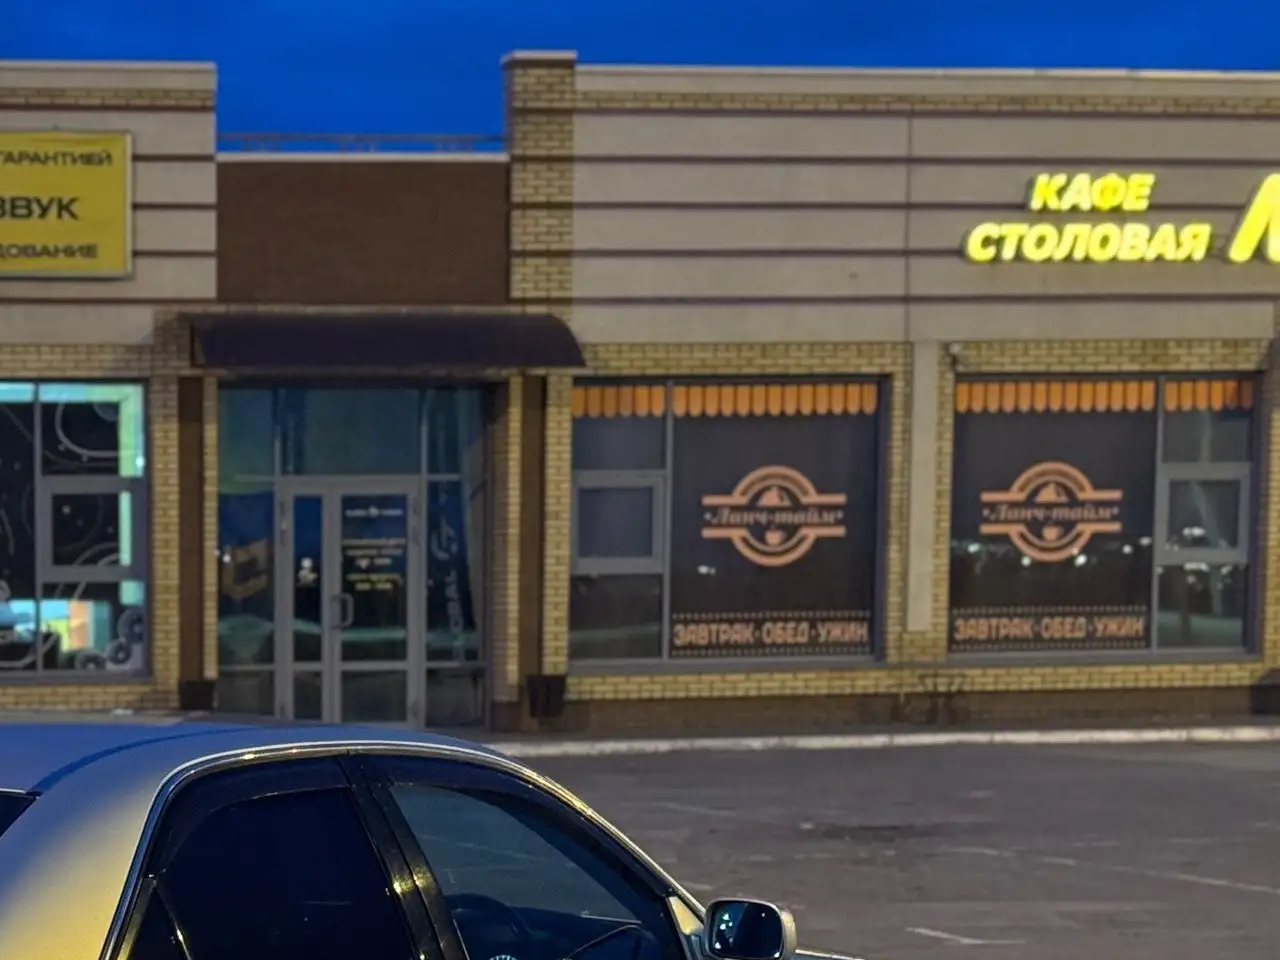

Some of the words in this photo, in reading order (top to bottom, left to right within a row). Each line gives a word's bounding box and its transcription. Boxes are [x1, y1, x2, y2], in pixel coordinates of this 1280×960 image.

[1030, 172, 1156, 212] КАФЕ
[966, 221, 1212, 262] СТОЛОВАЯ
[673, 621, 755, 647] ЗАВТРАК
[761, 620, 810, 644] ОБЕД
[816, 619, 869, 643] УЖИН
[953, 616, 1034, 641] ЗАВТРАК
[1040, 615, 1087, 638] ОБЕД
[1093, 614, 1145, 638] УЖИН
